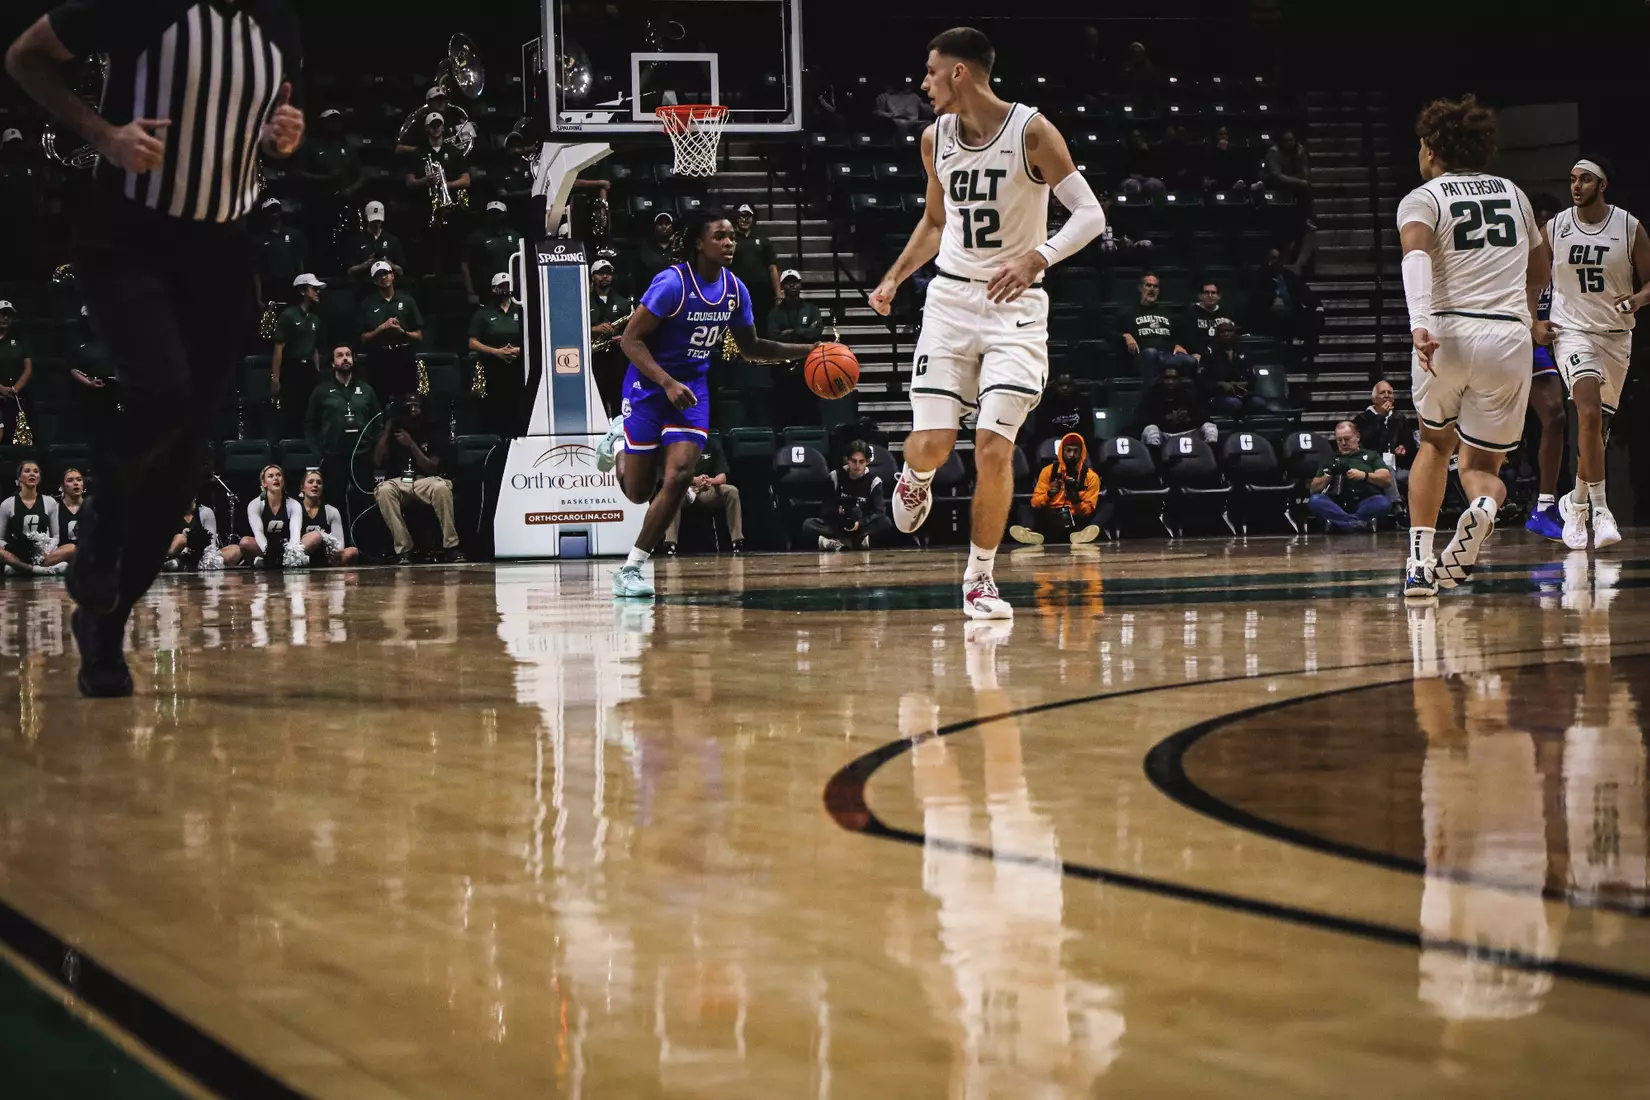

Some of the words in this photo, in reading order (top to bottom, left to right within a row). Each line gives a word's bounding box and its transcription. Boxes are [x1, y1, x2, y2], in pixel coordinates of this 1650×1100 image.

[949, 169, 1007, 202] CLT
[1440, 179, 1507, 197] PATTERSON
[958, 208, 1002, 248] 12
[1450, 199, 1517, 250] 25
[538, 252, 584, 263] SPALDING
[1568, 244, 1610, 265] CLT
[1576, 268, 1605, 293] 15
[689, 325, 720, 347] 20
[557, 353, 579, 369] OC
[687, 349, 710, 359] TECH
[528, 512, 621, 522] ORTHOCAROLINA.COM
